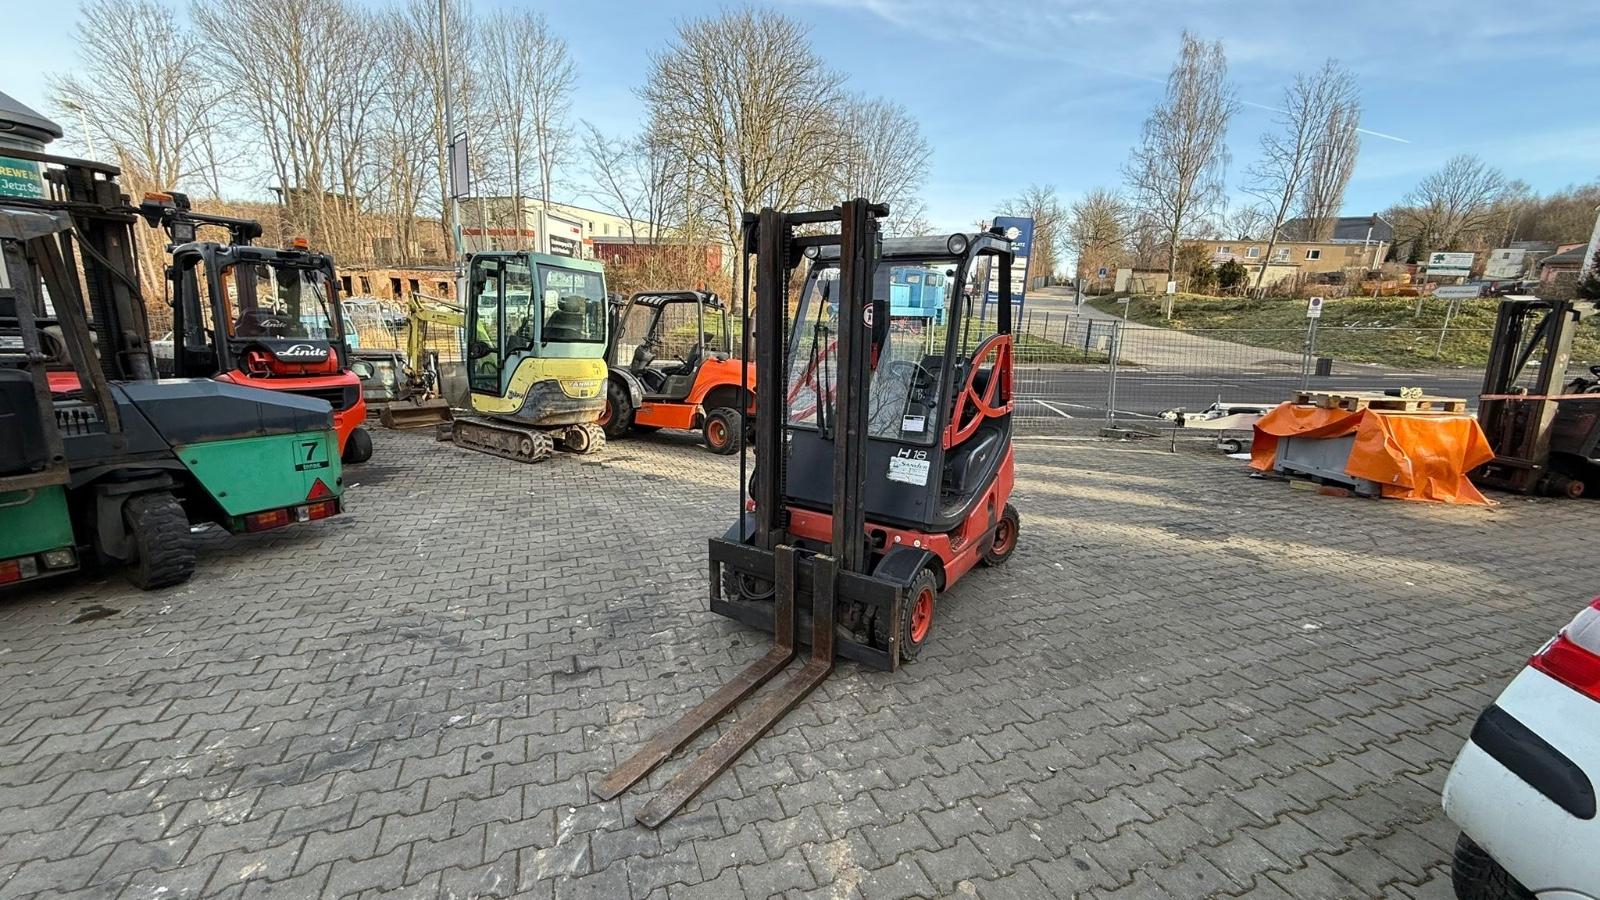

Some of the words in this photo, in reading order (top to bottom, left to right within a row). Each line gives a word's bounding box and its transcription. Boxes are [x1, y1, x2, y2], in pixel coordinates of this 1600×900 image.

[1, 178, 27, 191] Jetzt
[276, 344, 328, 356] Linde
[301, 441, 319, 461] 7
[897, 447, 911, 458] H
[913, 450, 927, 460] 18
